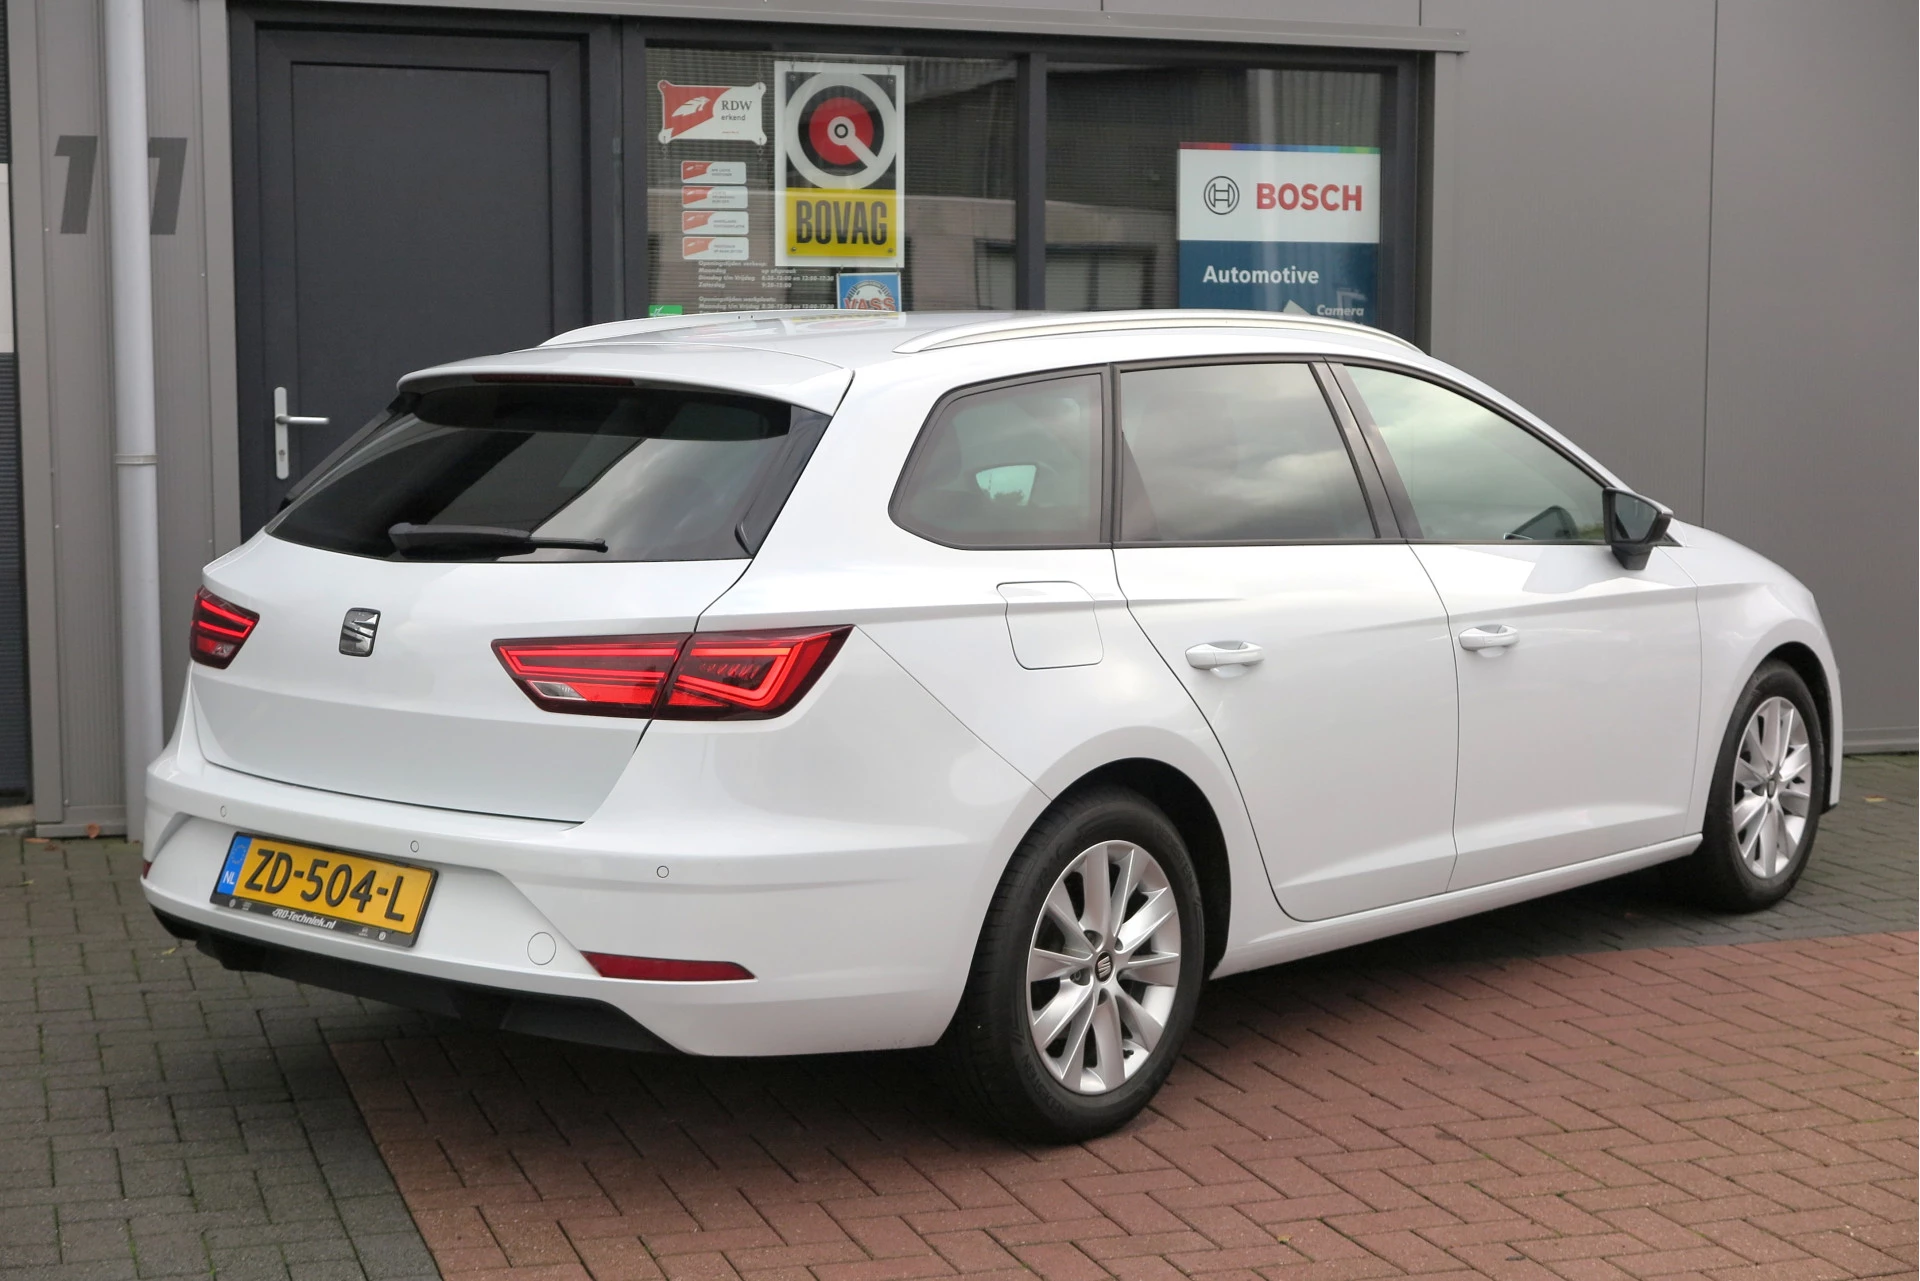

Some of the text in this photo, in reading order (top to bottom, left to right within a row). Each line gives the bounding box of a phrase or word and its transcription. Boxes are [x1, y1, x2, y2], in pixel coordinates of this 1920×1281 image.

[721, 100, 752, 111] RDW
[1256, 182, 1362, 212] BOSCH
[796, 201, 887, 245] BOVAG
[1202, 265, 1320, 284] Automotive
[1316, 304, 1364, 317] Camera
[223, 871, 235, 886] NL
[244, 848, 405, 922] ZD-504-L
